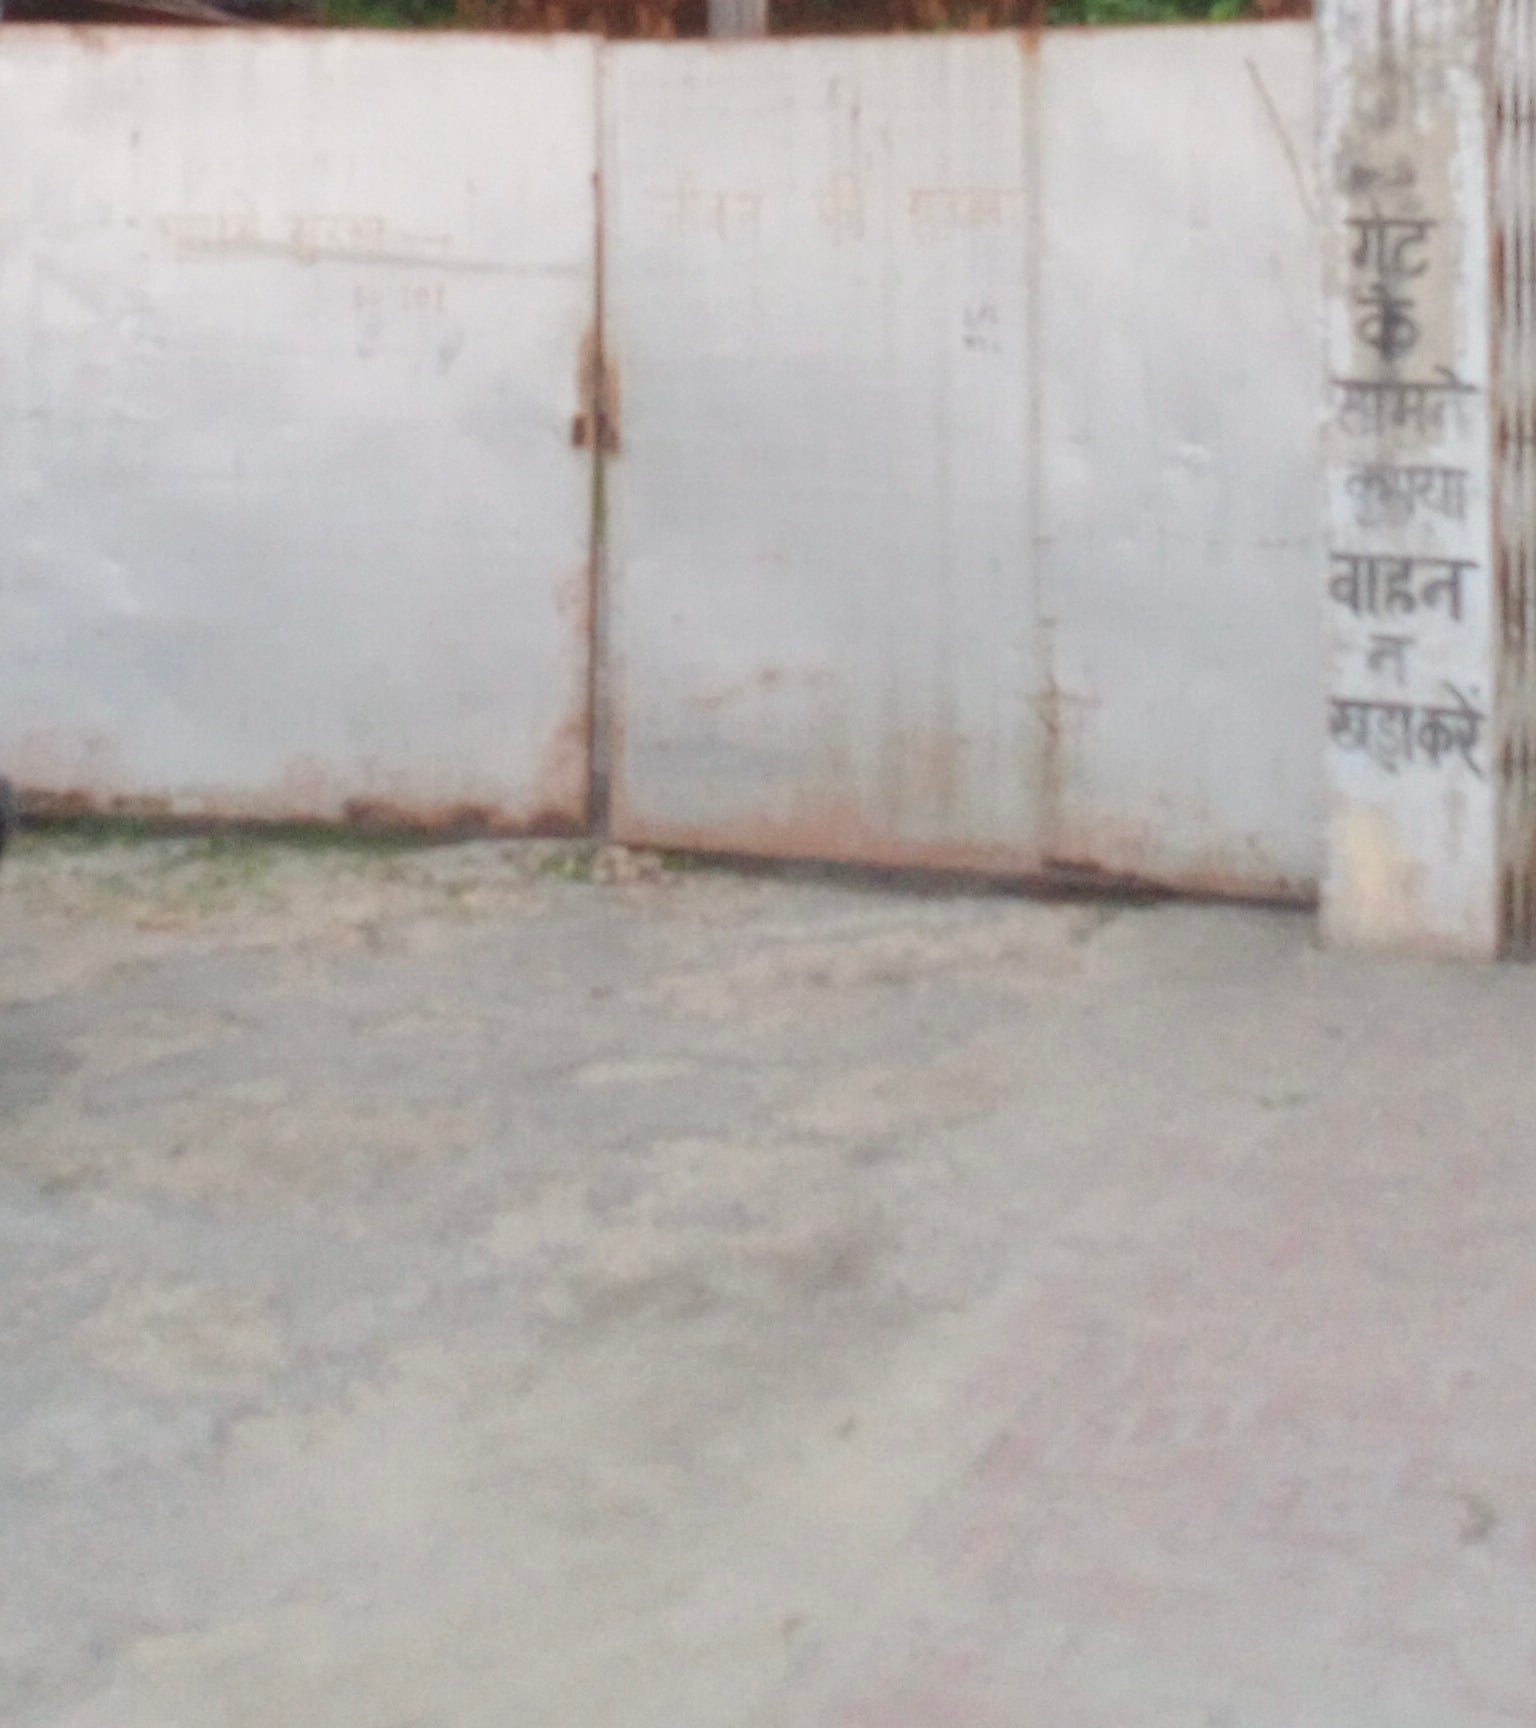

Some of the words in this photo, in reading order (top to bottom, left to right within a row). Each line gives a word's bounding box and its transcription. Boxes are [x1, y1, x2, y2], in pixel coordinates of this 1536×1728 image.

[1356, 283, 1420, 362] के
[1329, 553, 1480, 622] वाहन
[1367, 634, 1416, 684] न
